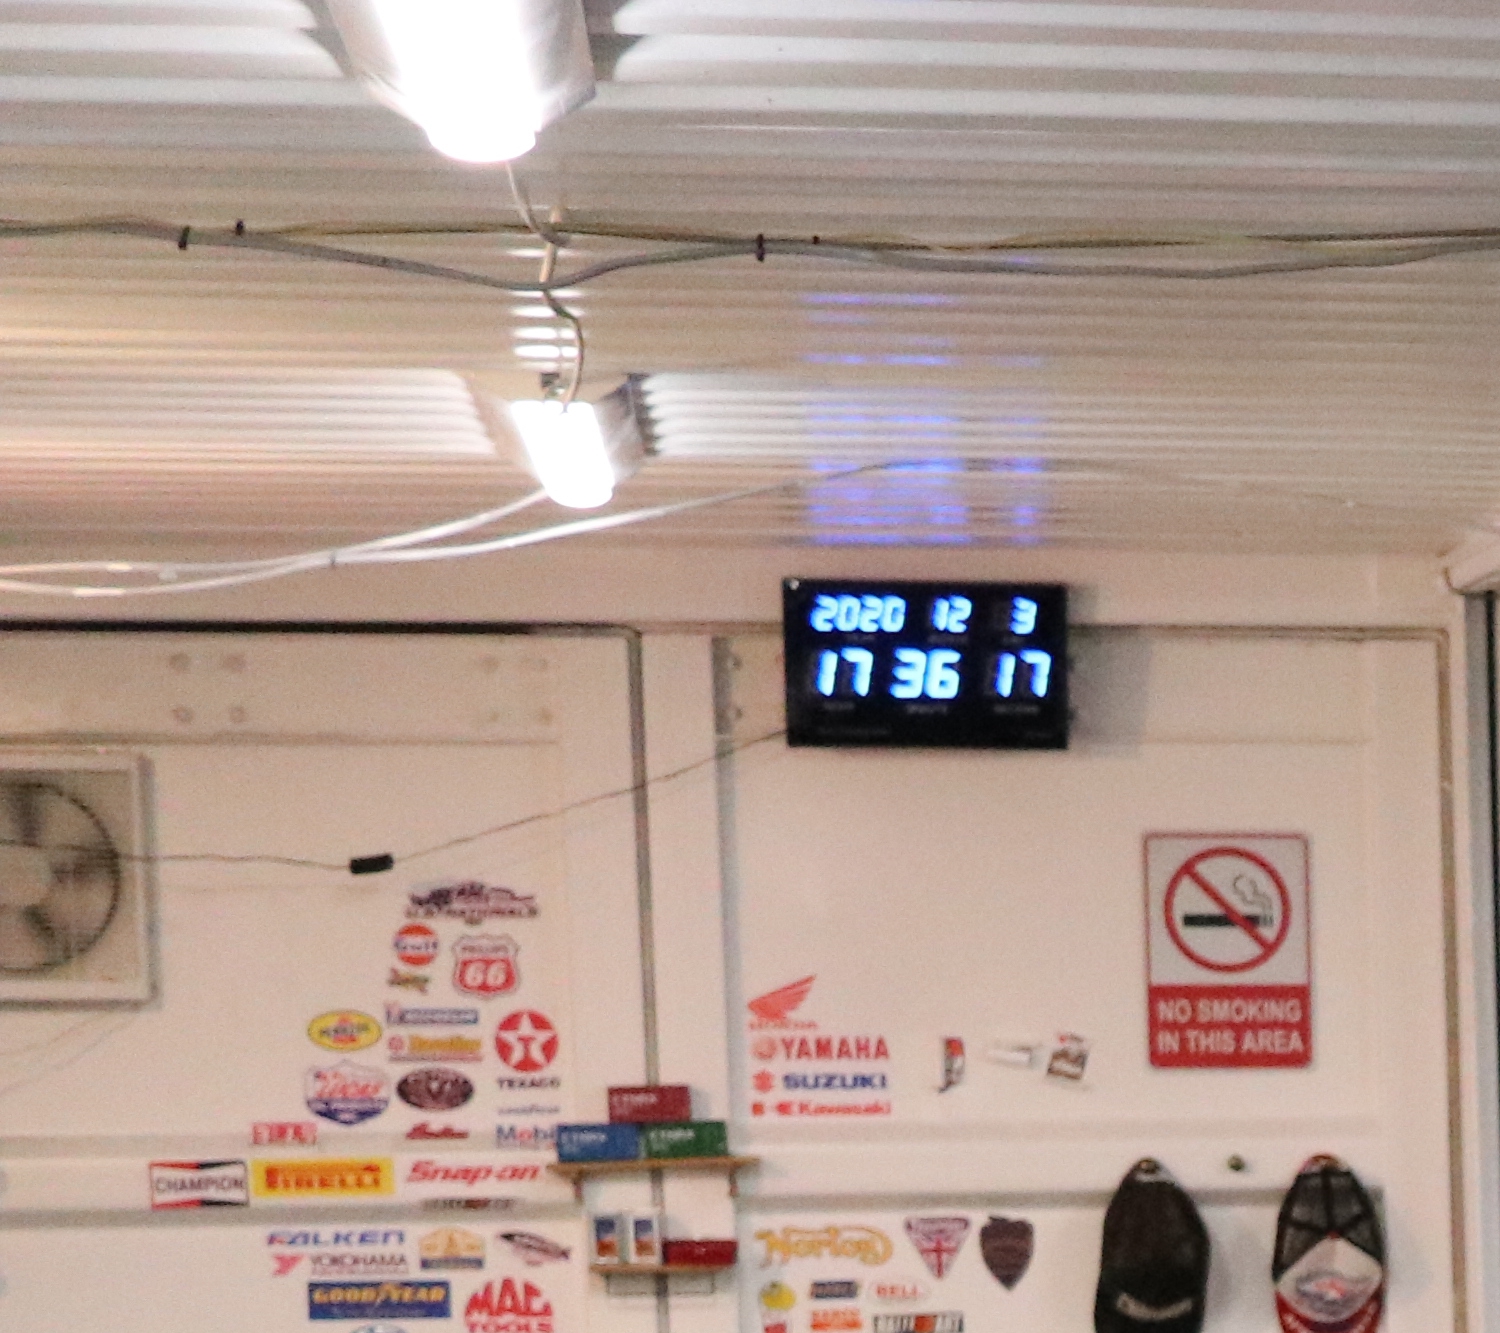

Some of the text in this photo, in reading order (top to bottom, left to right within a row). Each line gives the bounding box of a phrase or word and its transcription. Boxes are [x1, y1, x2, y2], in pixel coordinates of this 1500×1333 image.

[810, 594, 1038, 635] 2020 12 3
[816, 647, 1052, 699] 17 36 17
[464, 960, 508, 989] 66
[1159, 1000, 1302, 1024] NO SMOKING
[781, 1036, 890, 1060] YAMAHA
[1158, 1030, 1304, 1054] IN THIS AREA
[497, 1076, 561, 1091] TEXACO
[782, 1074, 887, 1089] SUZUKI
[264, 1164, 382, 1191] PIRELLI
[406, 1160, 542, 1185] Snap-on
[155, 1176, 246, 1194] CHAMPION
[266, 1230, 406, 1248] FALKEN
[309, 1252, 408, 1268] YOKOHAMA
[465, 1277, 554, 1317] MAC
